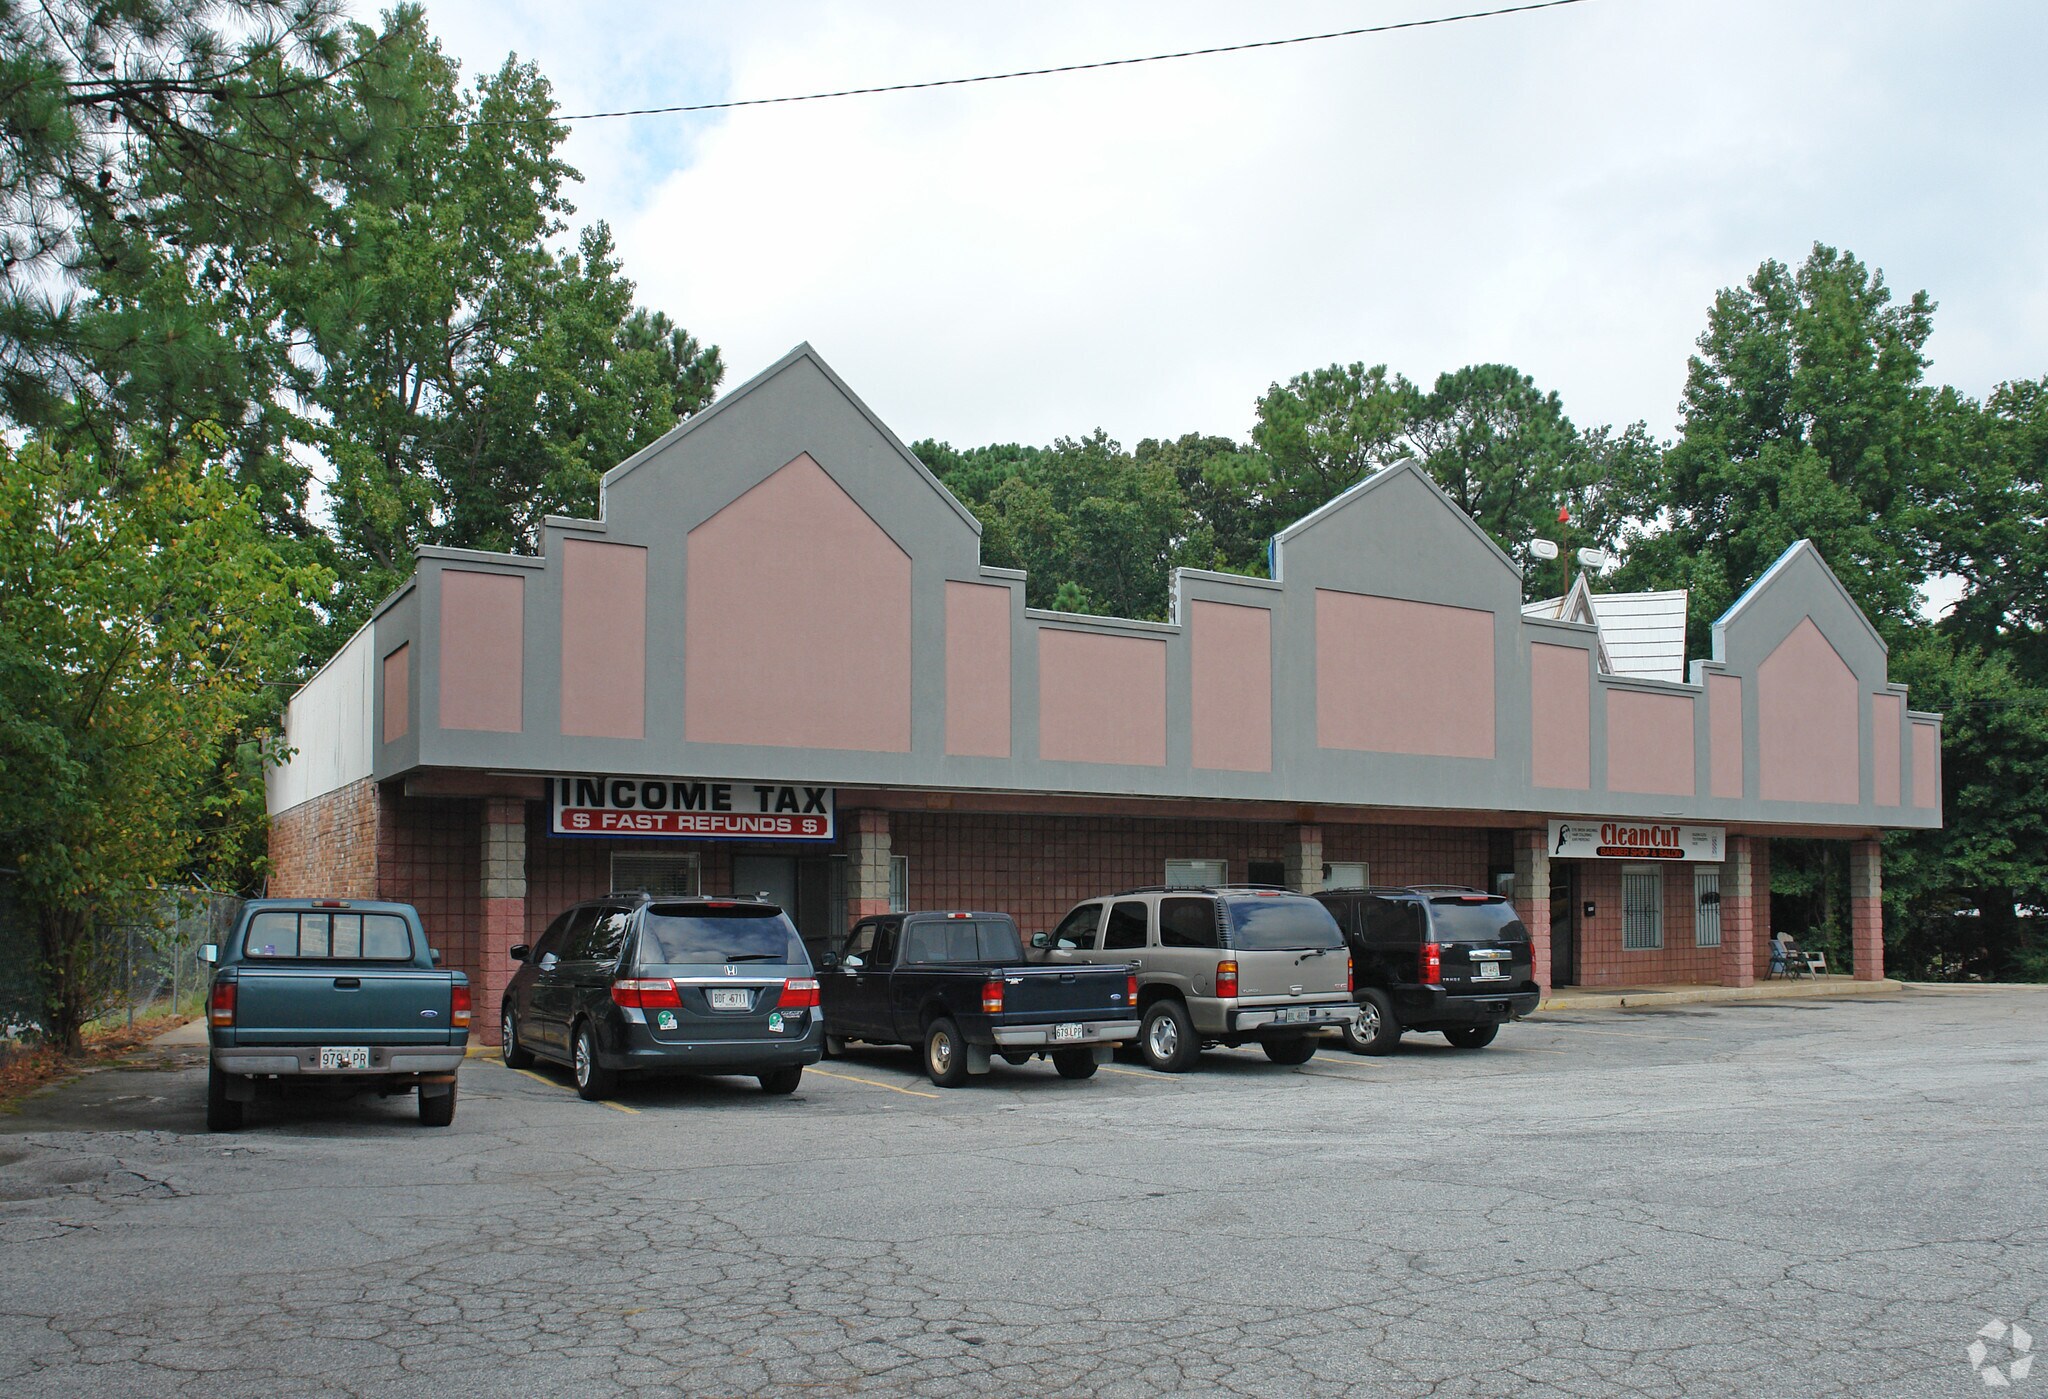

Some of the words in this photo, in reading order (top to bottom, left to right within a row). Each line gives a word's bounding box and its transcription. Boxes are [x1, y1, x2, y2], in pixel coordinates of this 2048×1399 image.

[560, 779, 732, 811] INCOME
[753, 785, 827, 814] TAX
[602, 814, 668, 830] FAST
[678, 815, 792, 832] REFUNDS
[1600, 847, 1629, 856] BARBER
[1630, 848, 1650, 857] SHOP
[1651, 849, 1657, 857] &
[1659, 849, 1682, 858] SALON
